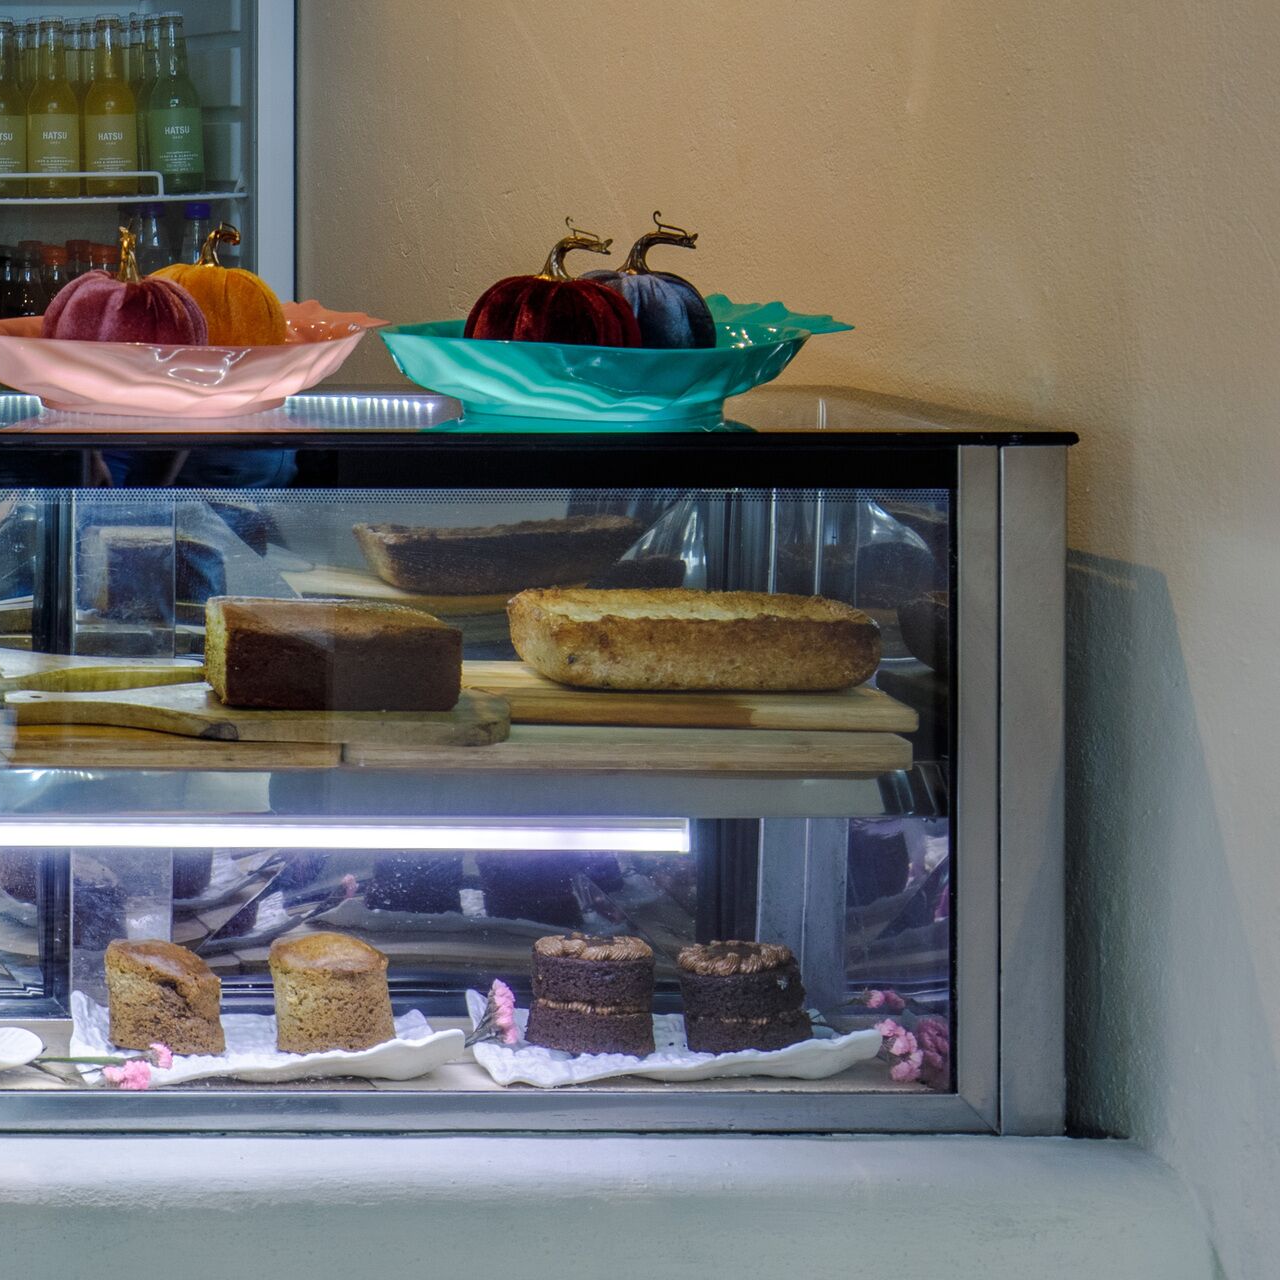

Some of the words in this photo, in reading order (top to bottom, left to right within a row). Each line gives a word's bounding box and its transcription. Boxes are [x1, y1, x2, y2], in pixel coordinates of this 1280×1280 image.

[164, 125, 190, 135] HATSU
[42, 131, 68, 140] HATSU
[98, 132, 123, 141] HATSU
